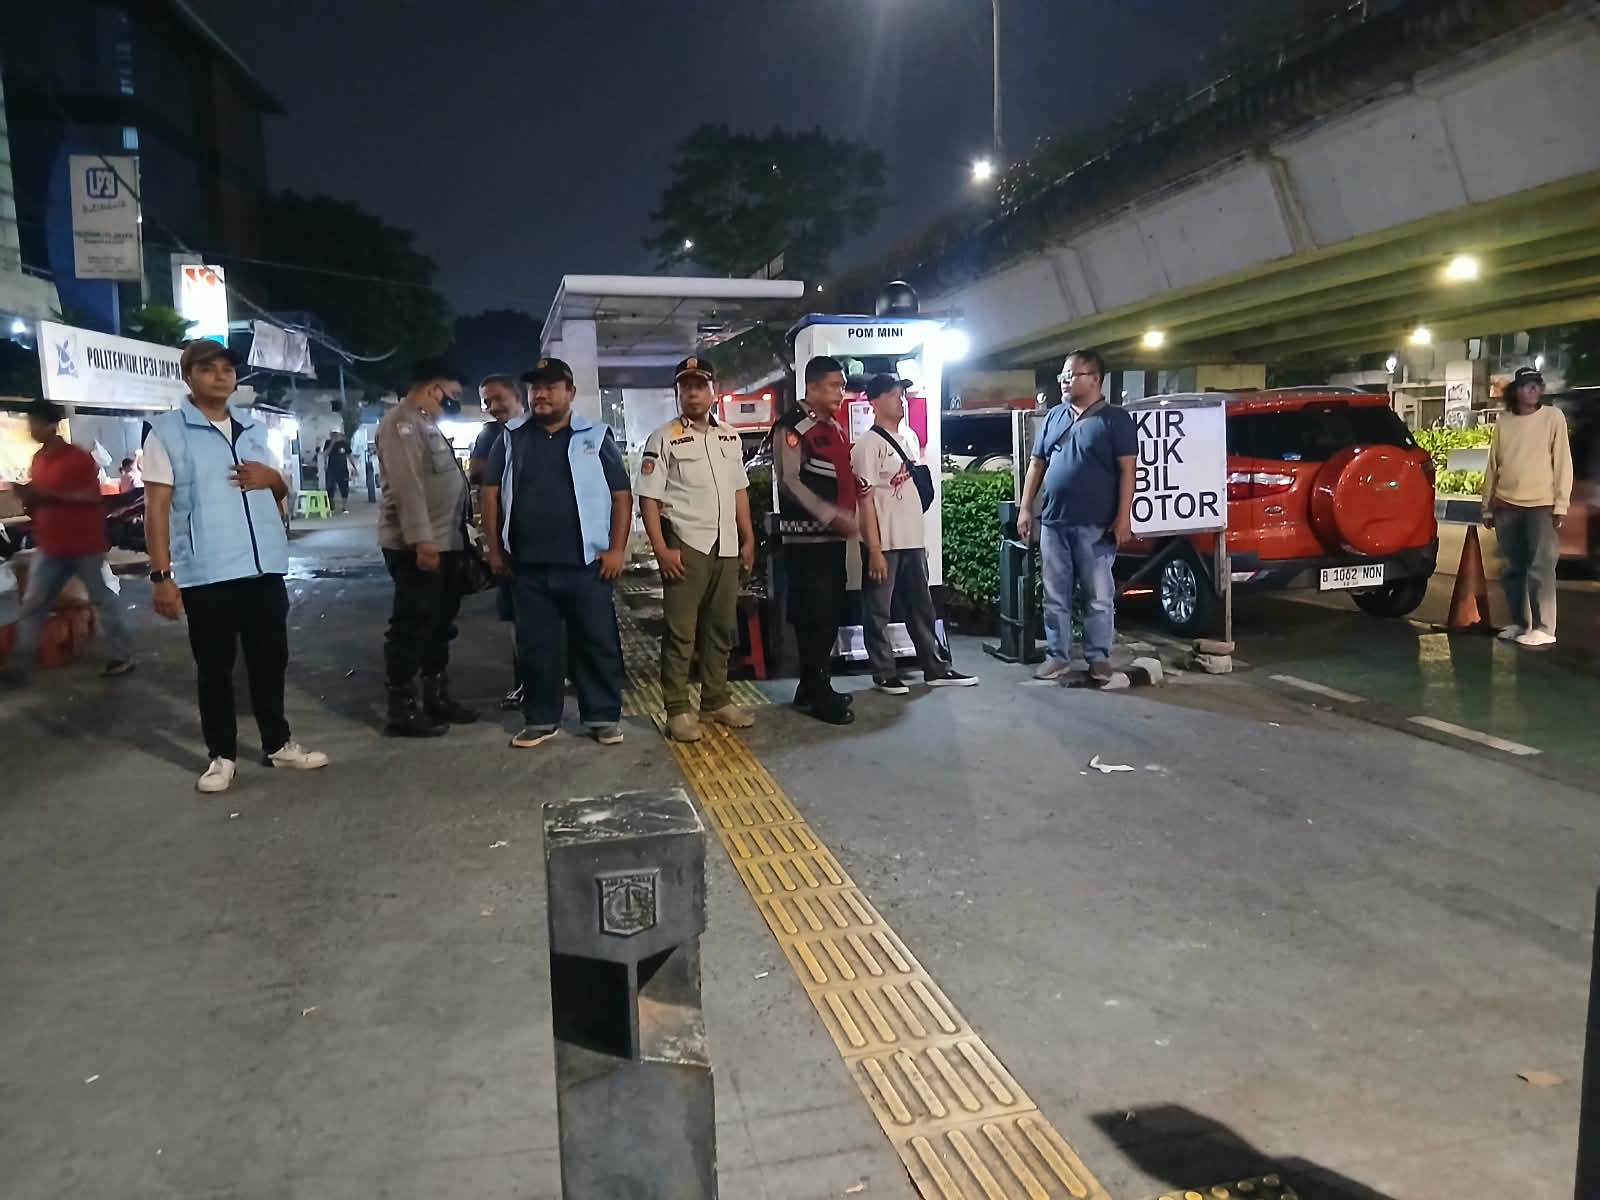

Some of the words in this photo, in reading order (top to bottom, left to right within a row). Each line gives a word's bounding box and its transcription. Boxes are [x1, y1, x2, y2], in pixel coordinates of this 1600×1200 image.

[848, 327, 874, 339] POM
[877, 327, 903, 338] MINI
[86, 346, 138, 374] POLITEKNIK
[1322, 570, 1329, 583] B
[1333, 567, 1358, 582] 1062
[1362, 566, 1382, 579] NON
